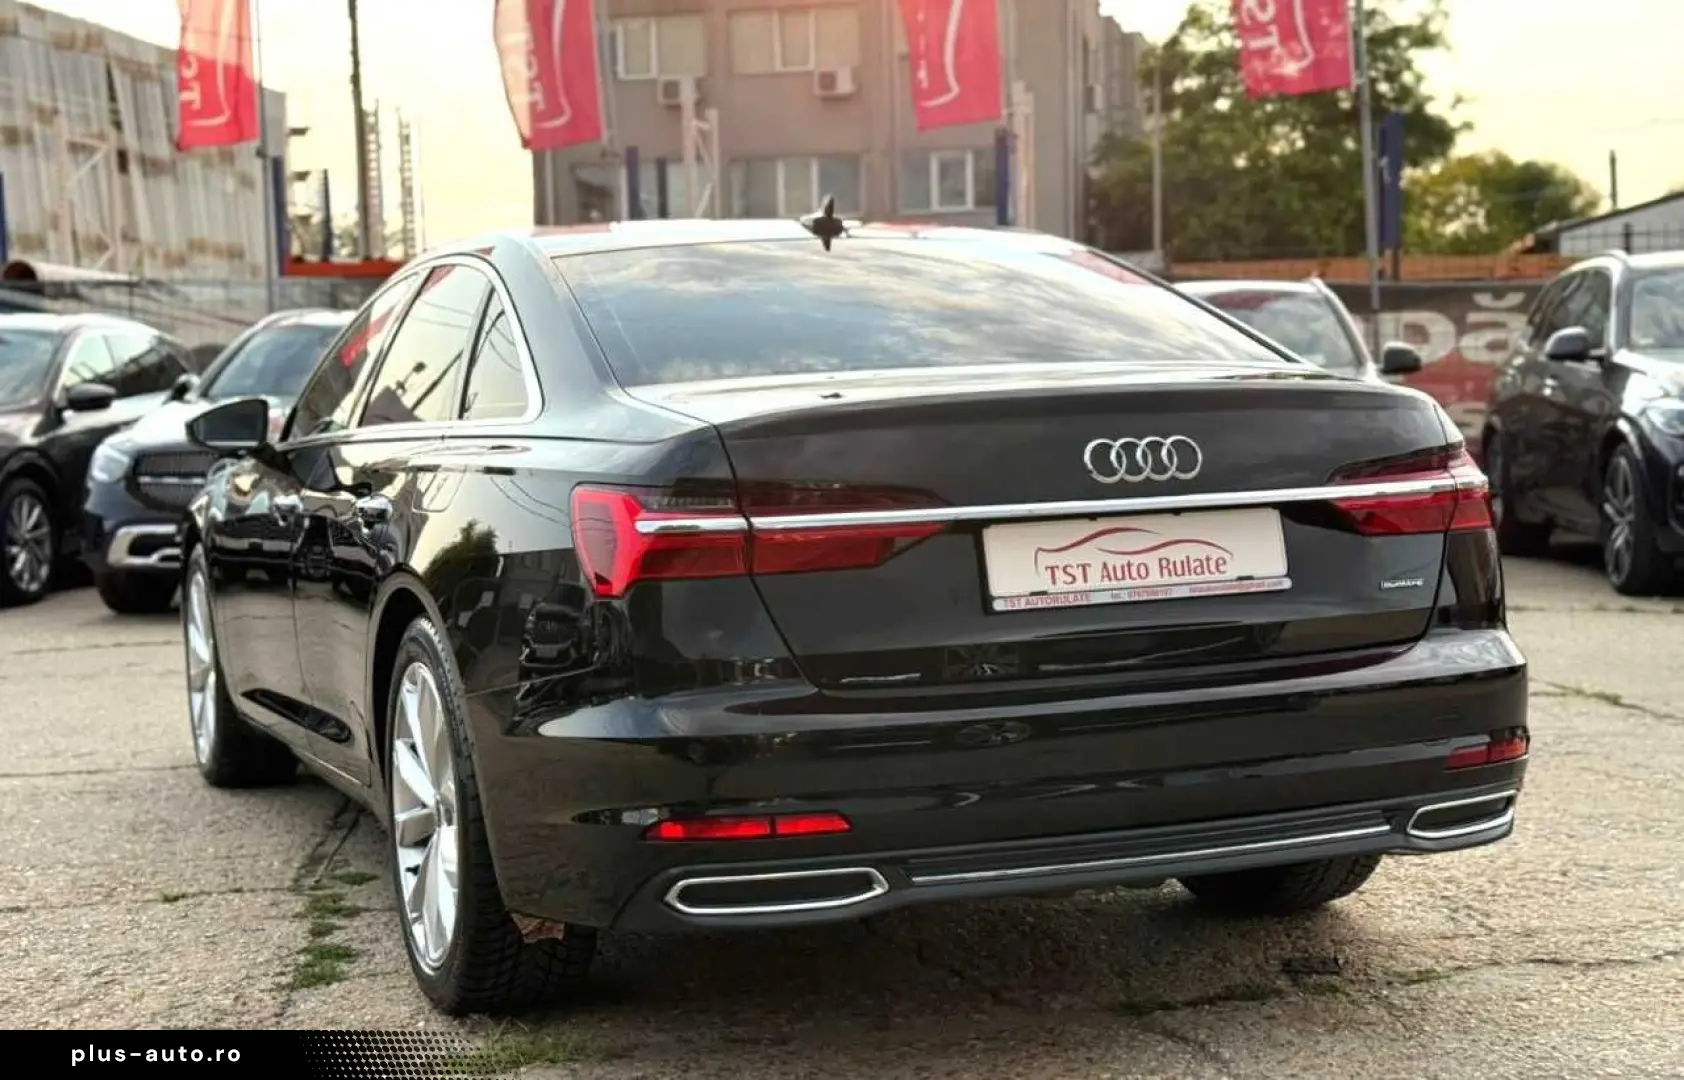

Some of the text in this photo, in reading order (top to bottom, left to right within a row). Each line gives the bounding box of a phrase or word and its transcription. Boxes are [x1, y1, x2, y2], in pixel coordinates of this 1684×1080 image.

[1044, 555, 1227, 586] TST Auto Rulate
